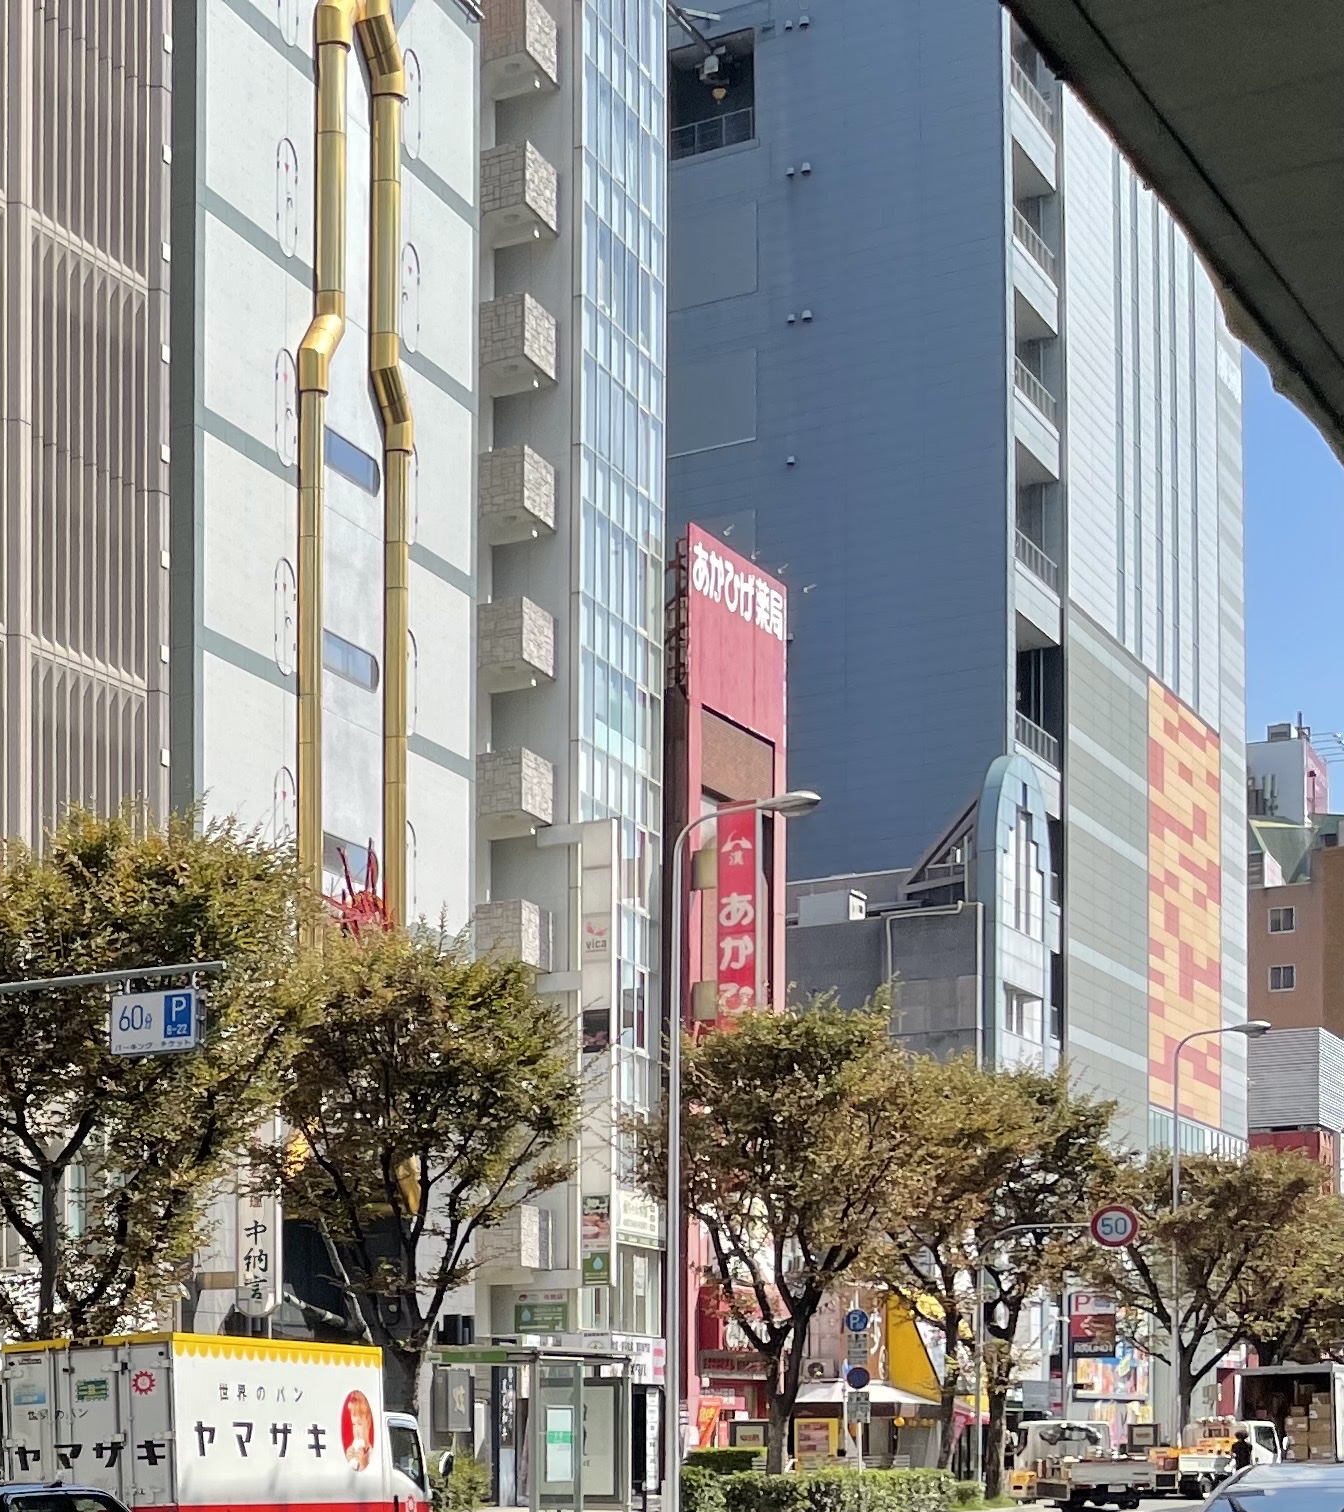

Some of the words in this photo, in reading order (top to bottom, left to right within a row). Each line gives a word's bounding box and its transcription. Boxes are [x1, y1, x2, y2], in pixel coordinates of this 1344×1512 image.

[692, 541, 784, 641] あかひげ薬局
[585, 936, 607, 948] vica
[171, 996, 187, 1022] P
[1100, 1216, 1128, 1236] 50
[243, 1220, 268, 1300] 中納言
[1075, 1294, 1091, 1312] P
[218, 1383, 304, 1403] 世界のパン
[194, 1420, 327, 1458] ヤマザキ
